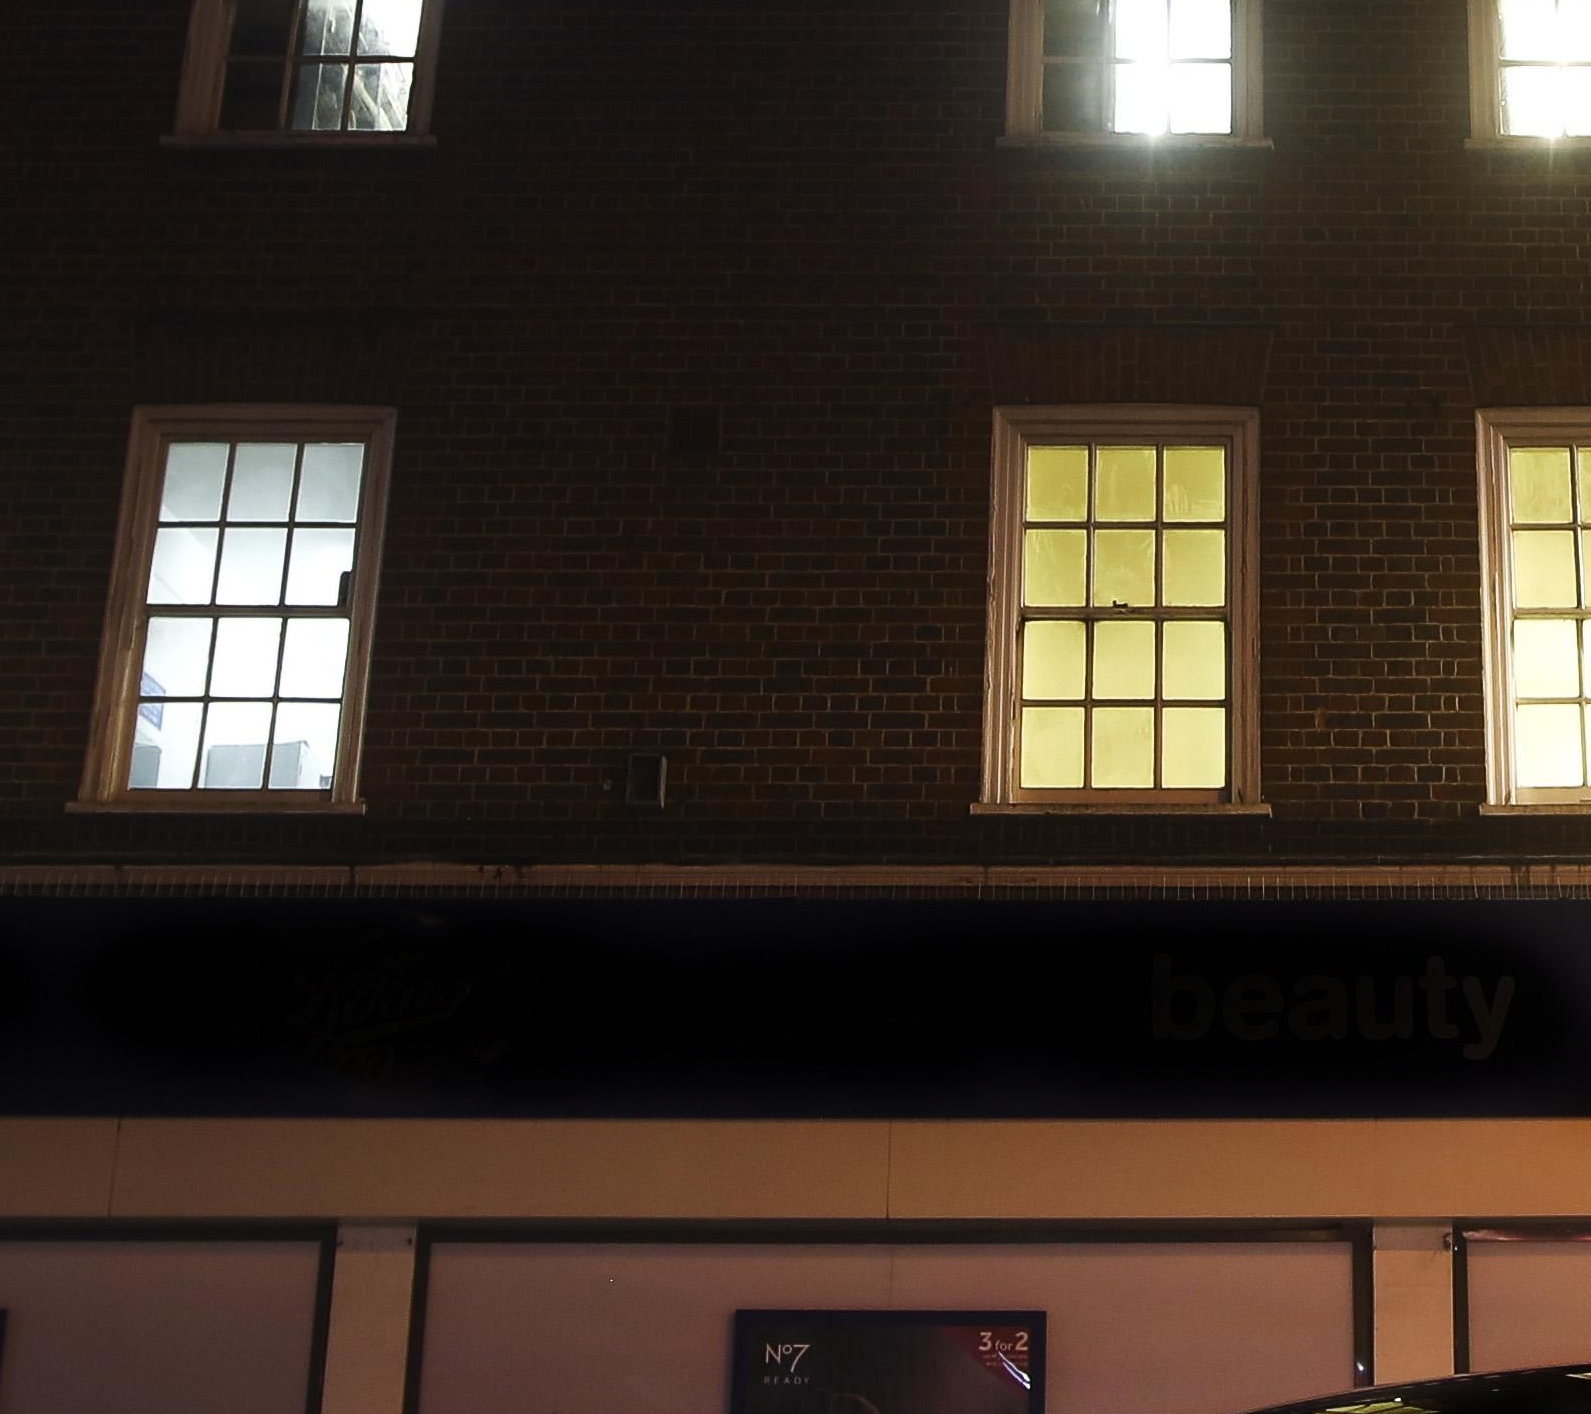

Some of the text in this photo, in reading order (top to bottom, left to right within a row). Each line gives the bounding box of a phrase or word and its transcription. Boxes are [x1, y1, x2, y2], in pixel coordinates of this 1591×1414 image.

[1153, 952, 1516, 1060] beauty
[978, 1331, 1029, 1352] 3 for 2
